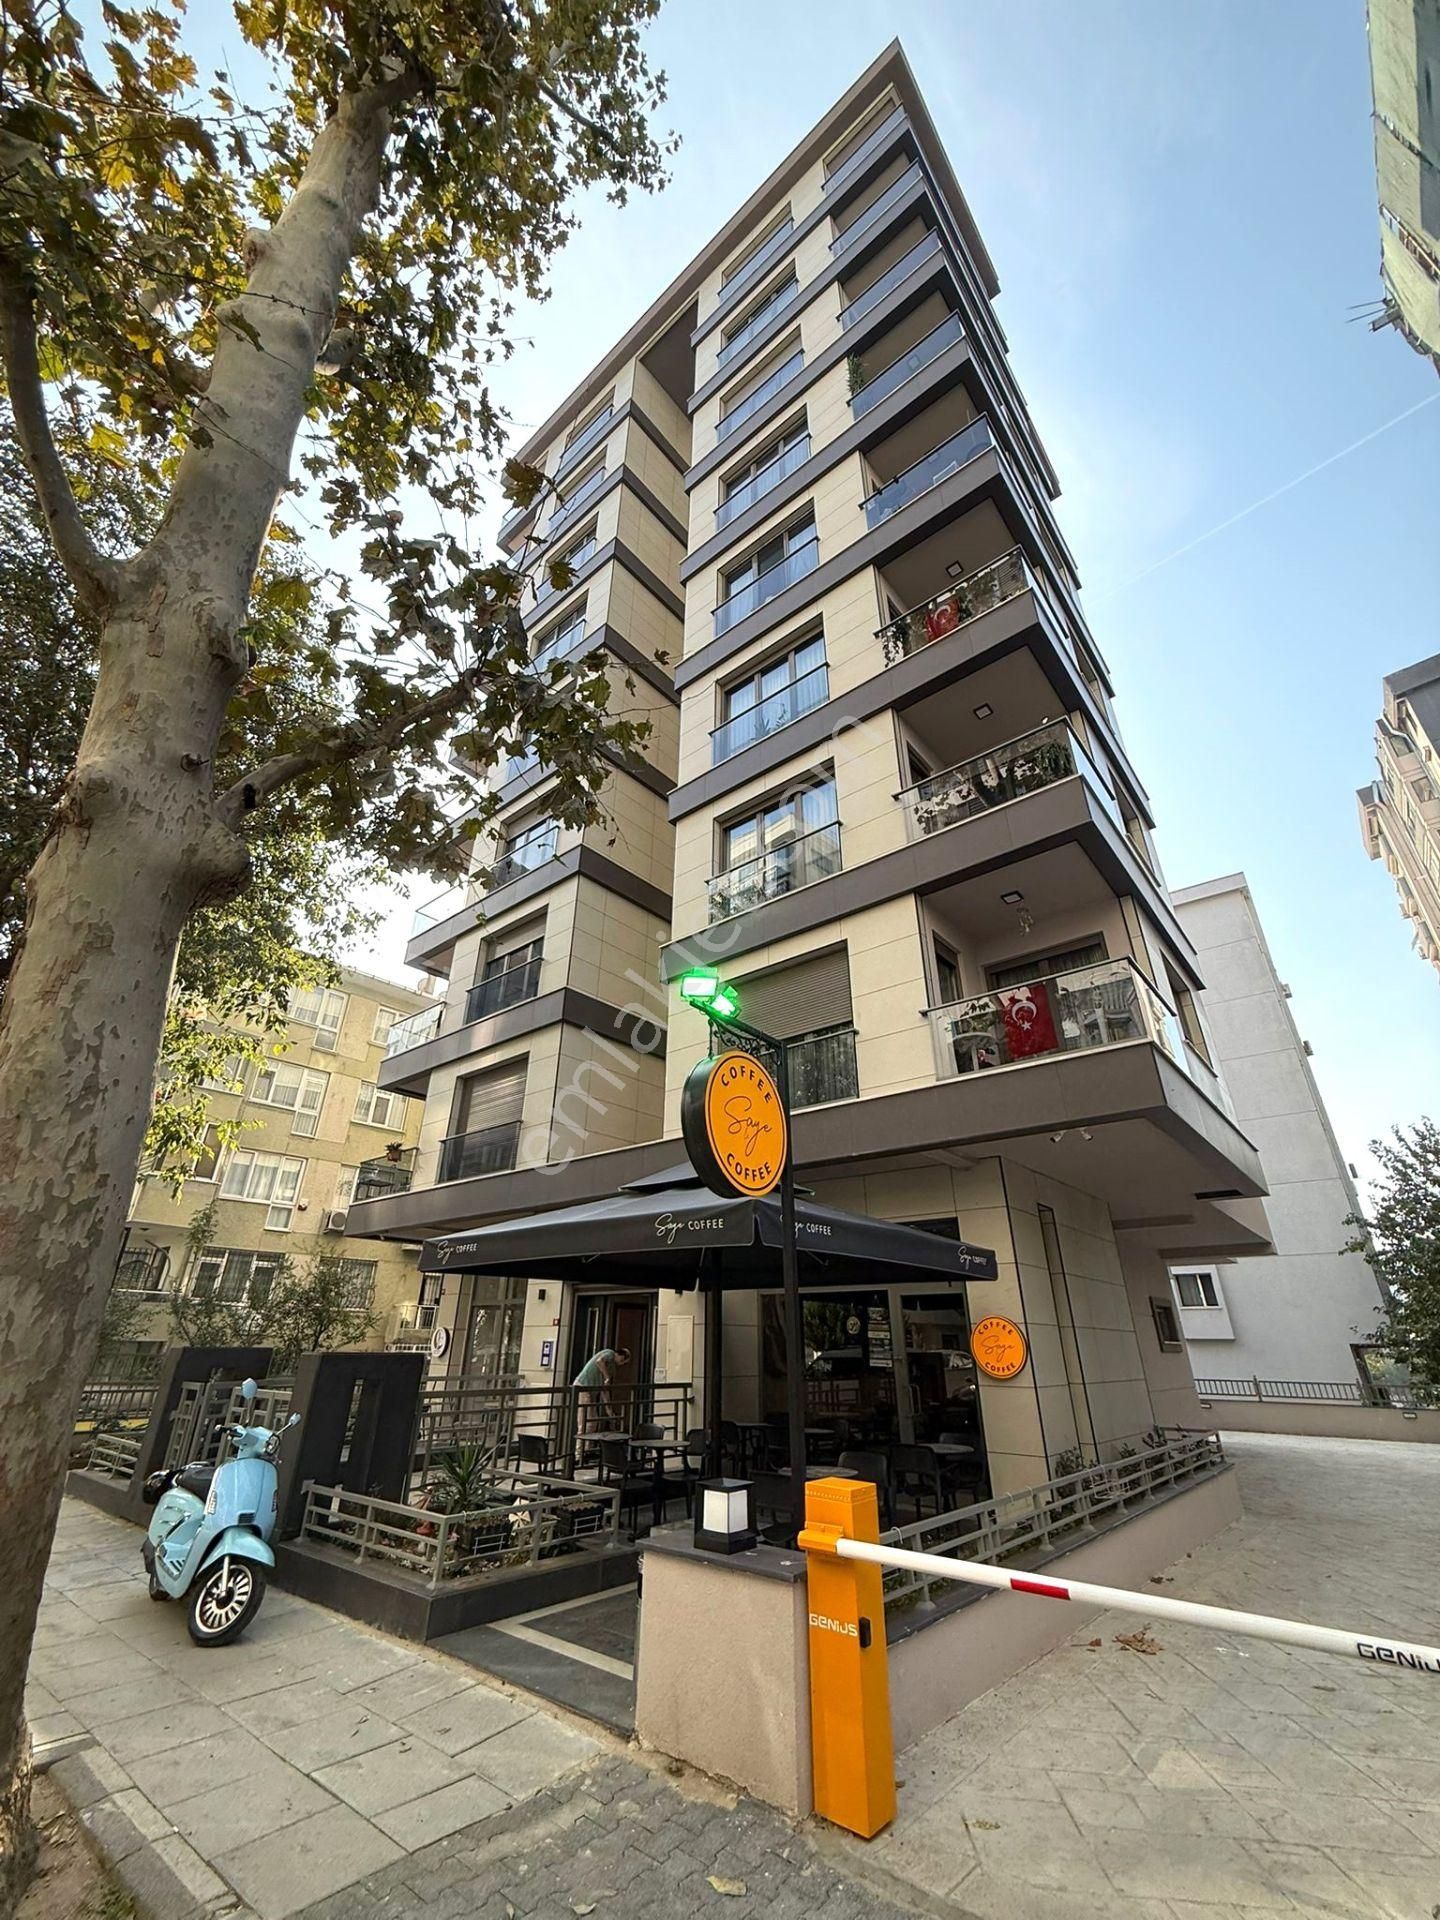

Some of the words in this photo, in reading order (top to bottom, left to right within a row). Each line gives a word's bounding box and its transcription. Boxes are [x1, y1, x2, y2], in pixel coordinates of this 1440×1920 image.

[721, 1065, 772, 1103] COFFEE
[726, 1152, 772, 1182] COFFEE
[687, 1218, 725, 1231] COFFEE
[805, 1222, 832, 1236] COFFEE
[977, 1321, 1014, 1335] COFFEE
[985, 1361, 1017, 1373] COFFEE
